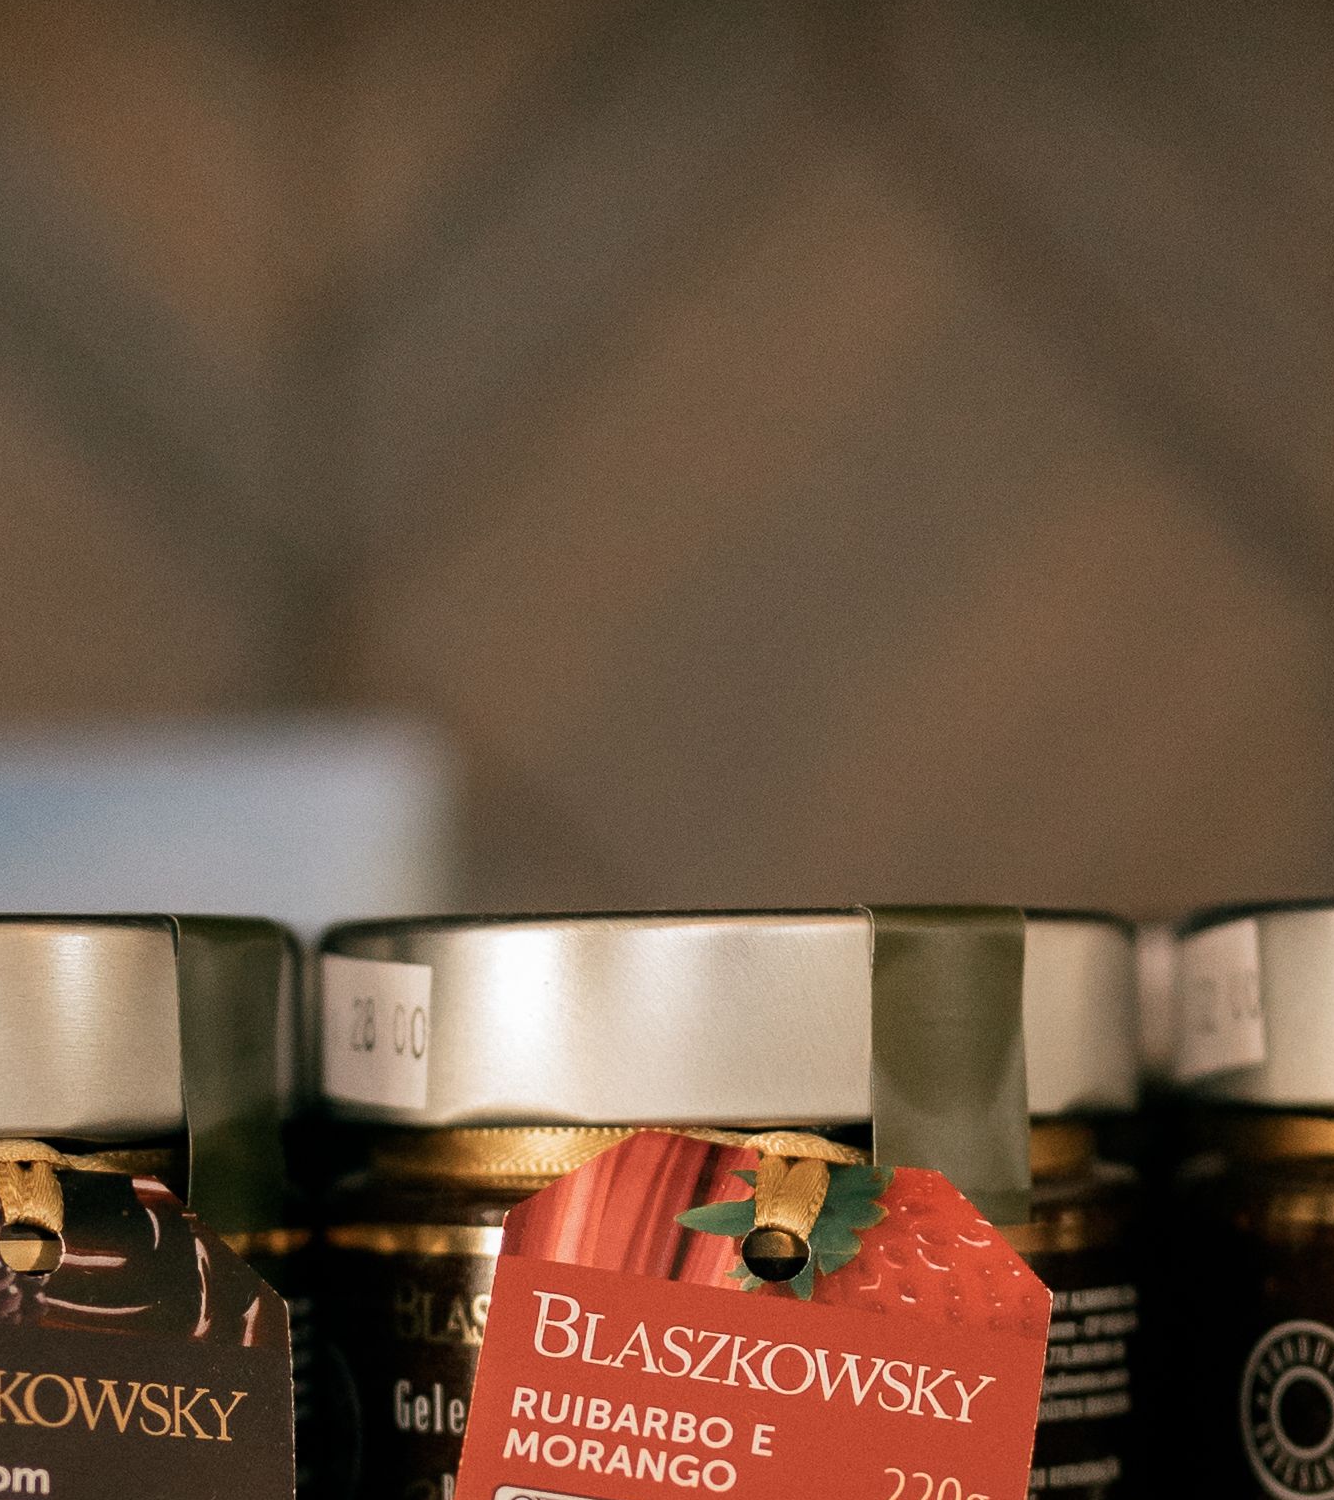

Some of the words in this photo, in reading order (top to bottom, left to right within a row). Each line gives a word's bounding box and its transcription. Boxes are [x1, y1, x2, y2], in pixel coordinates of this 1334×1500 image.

[531, 1289, 997, 1425] BLASZKOWSKY
[392, 1378, 466, 1435] Gele
[510, 1386, 734, 1450] RUIBARBO
[750, 1423, 776, 1457] E
[501, 1427, 737, 1494] MORANGO
